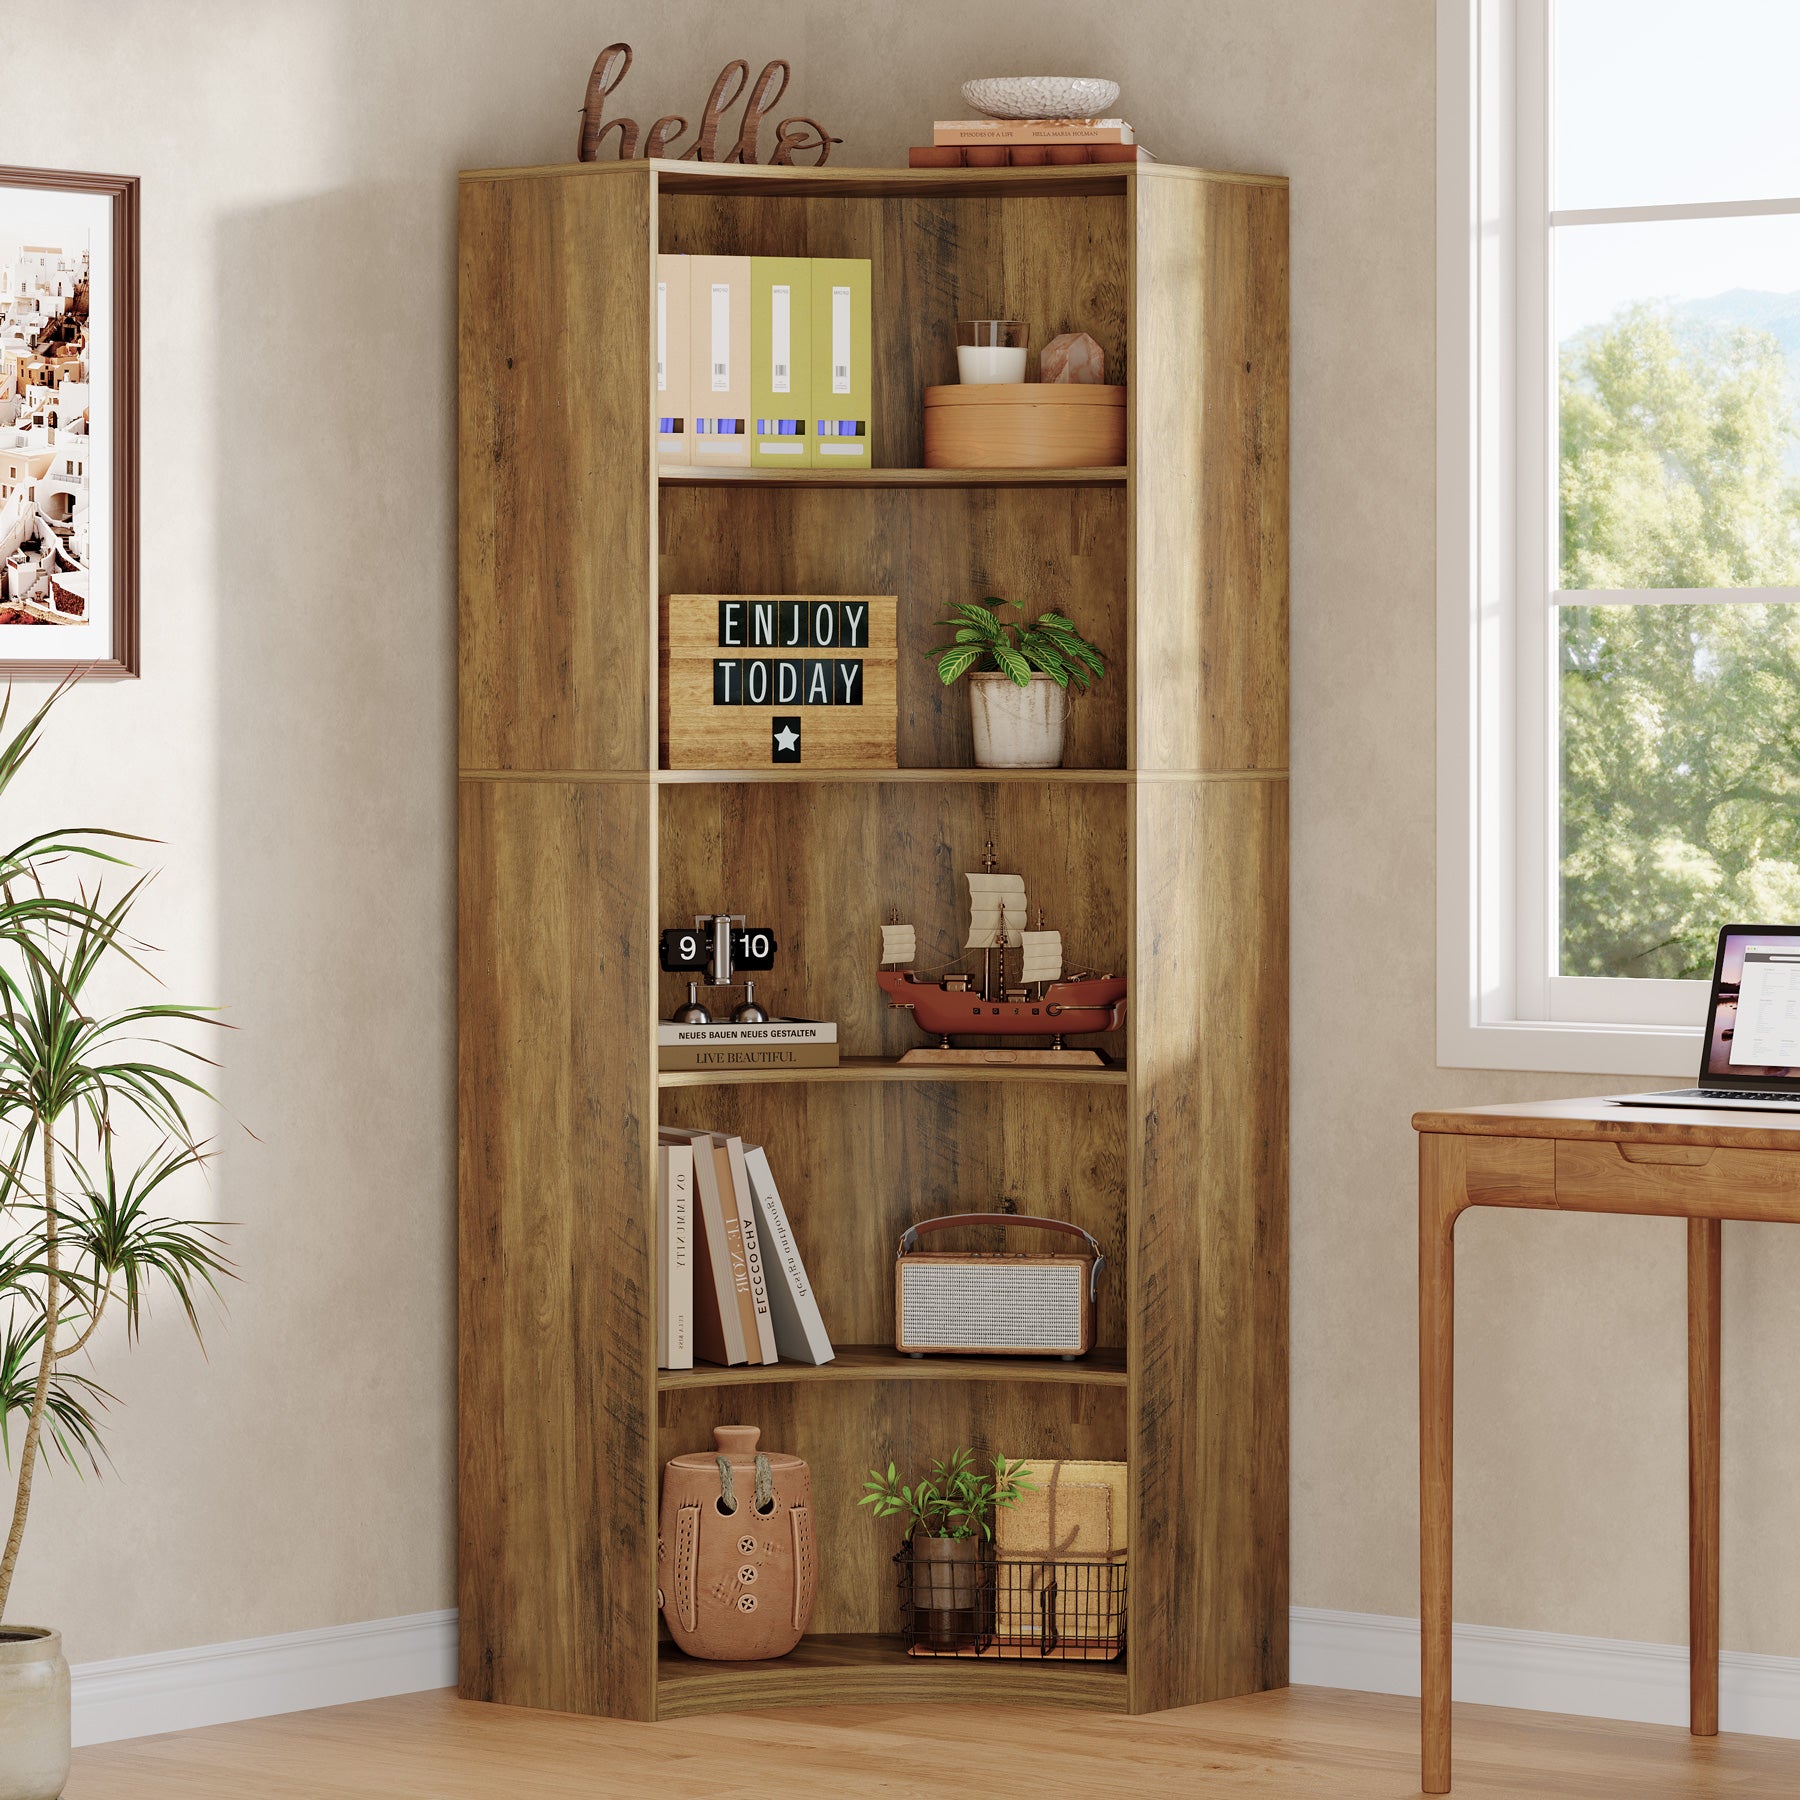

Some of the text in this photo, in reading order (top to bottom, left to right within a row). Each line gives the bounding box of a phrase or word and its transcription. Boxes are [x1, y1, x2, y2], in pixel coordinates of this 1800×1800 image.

[577, 43, 843, 166] hello
[725, 603, 863, 647] ENJOY
[719, 661, 858, 704] TODAY
[679, 934, 769, 961] 9 10
[678, 1029, 817, 1040] NEUES BAUEN NEUES GESTALTEN
[696, 1052, 797, 1064] LIVE BEAUTIFUL
